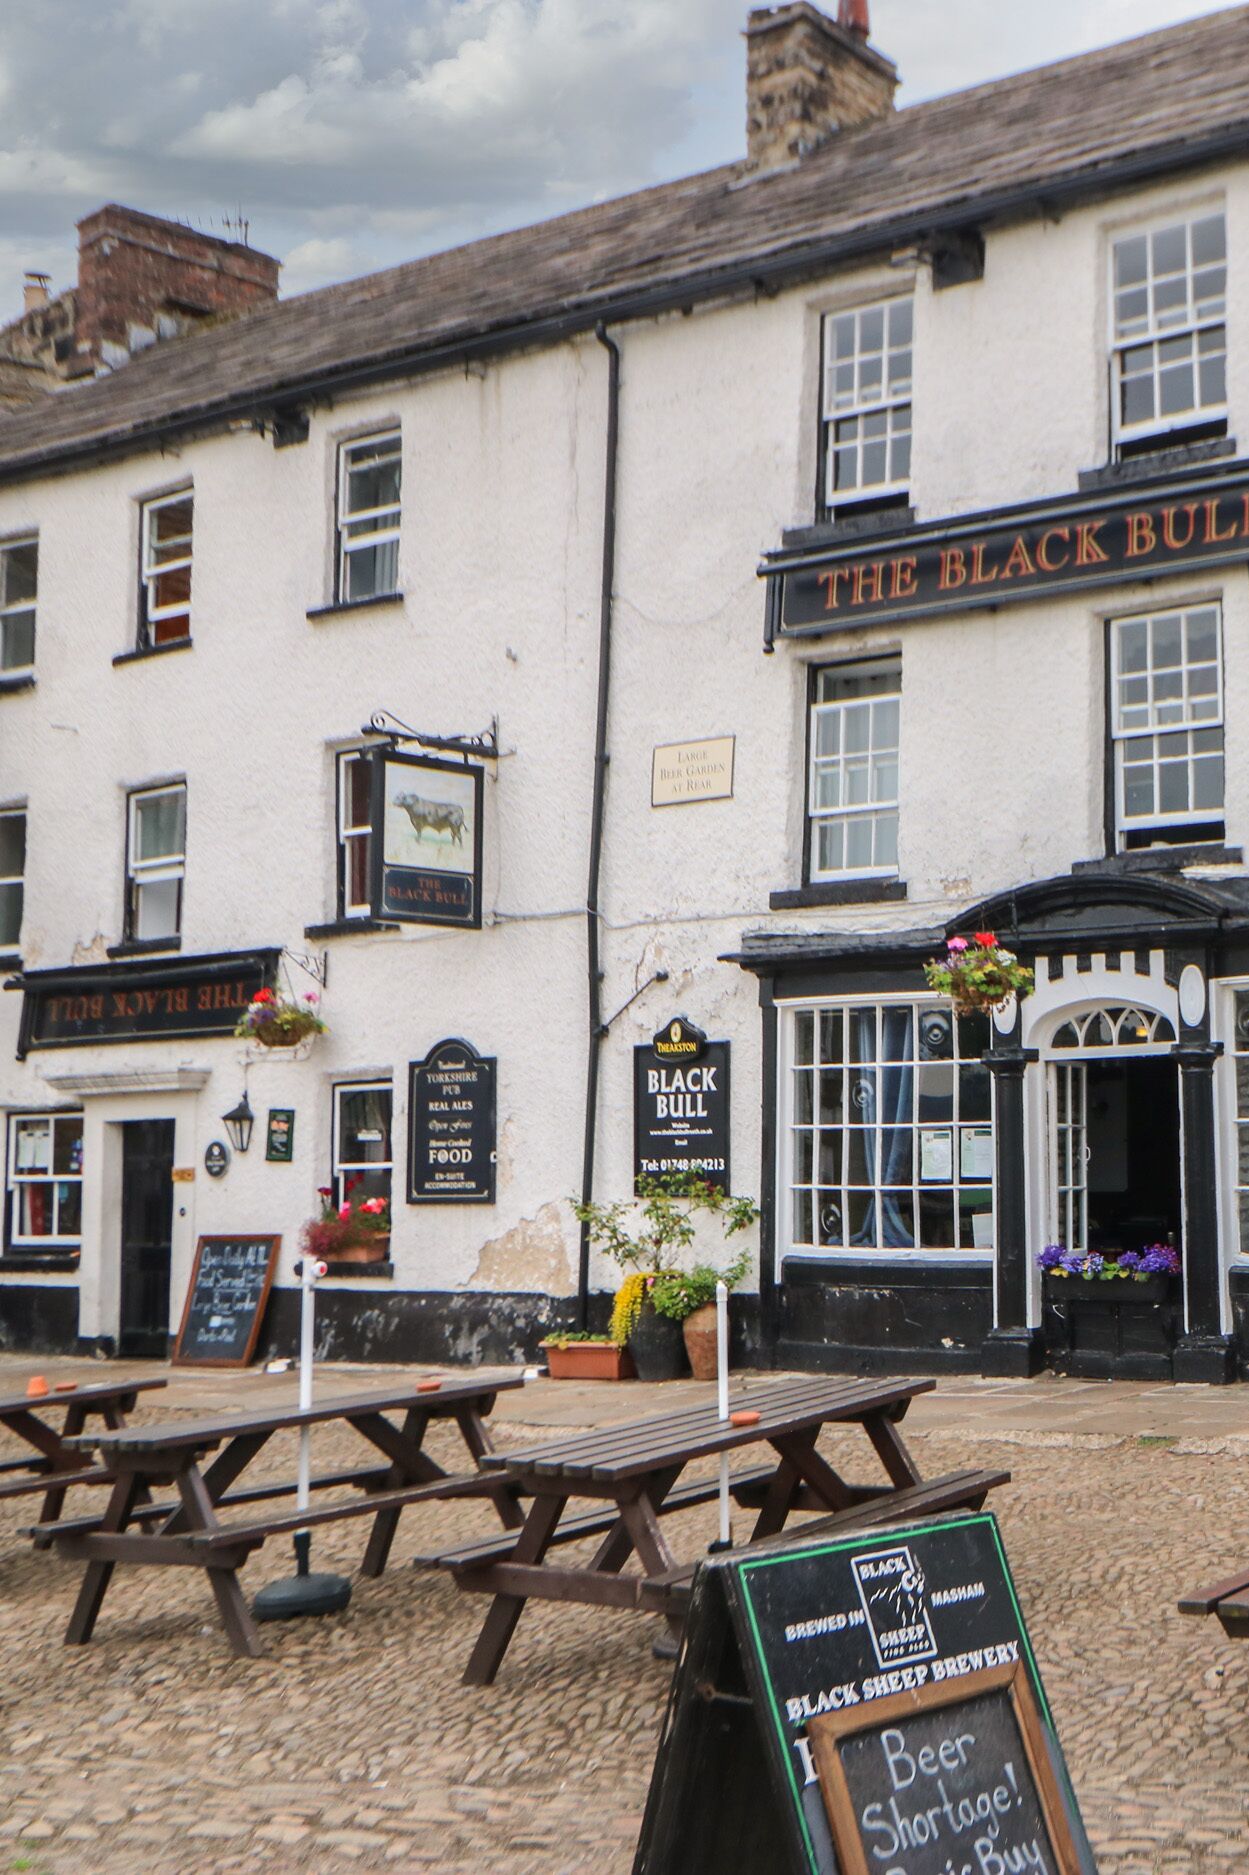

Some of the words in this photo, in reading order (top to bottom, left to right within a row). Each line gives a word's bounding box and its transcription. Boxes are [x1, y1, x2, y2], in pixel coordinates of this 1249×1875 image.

[817, 555, 918, 611] THE
[937, 520, 1110, 591] BLACK
[687, 779, 712, 792] REAR
[388, 886, 430, 902] BLACK
[48, 994, 103, 1023] BULL
[111, 987, 190, 1018] BLACK
[197, 981, 250, 1009] THE
[656, 1041, 697, 1054] THEAKSTON
[426, 1071, 478, 1084] YORKSHIRE
[442, 1084, 461, 1095] PUB
[647, 1066, 718, 1094] BLACK
[428, 1101, 450, 1112] REAL
[452, 1100, 473, 1111] ALES
[656, 1093, 708, 1119] BULL
[428, 1148, 473, 1164] FOOD
[640, 1159, 659, 1172] Tel:
[660, 1158, 689, 1172] 01748
[859, 1555, 907, 1581] BLACK
[930, 1581, 986, 1608] MASHAM
[784, 1612, 846, 1642] BREWED
[847, 1608, 866, 1628] IN
[879, 1623, 926, 1650] SHEEP
[785, 1680, 861, 1721] BLACK
[861, 1662, 929, 1703] SHEEP
[931, 1640, 1020, 1683] BREWERY
[880, 1728, 976, 1791] Beer
[861, 1761, 1023, 1860] Shortage!
